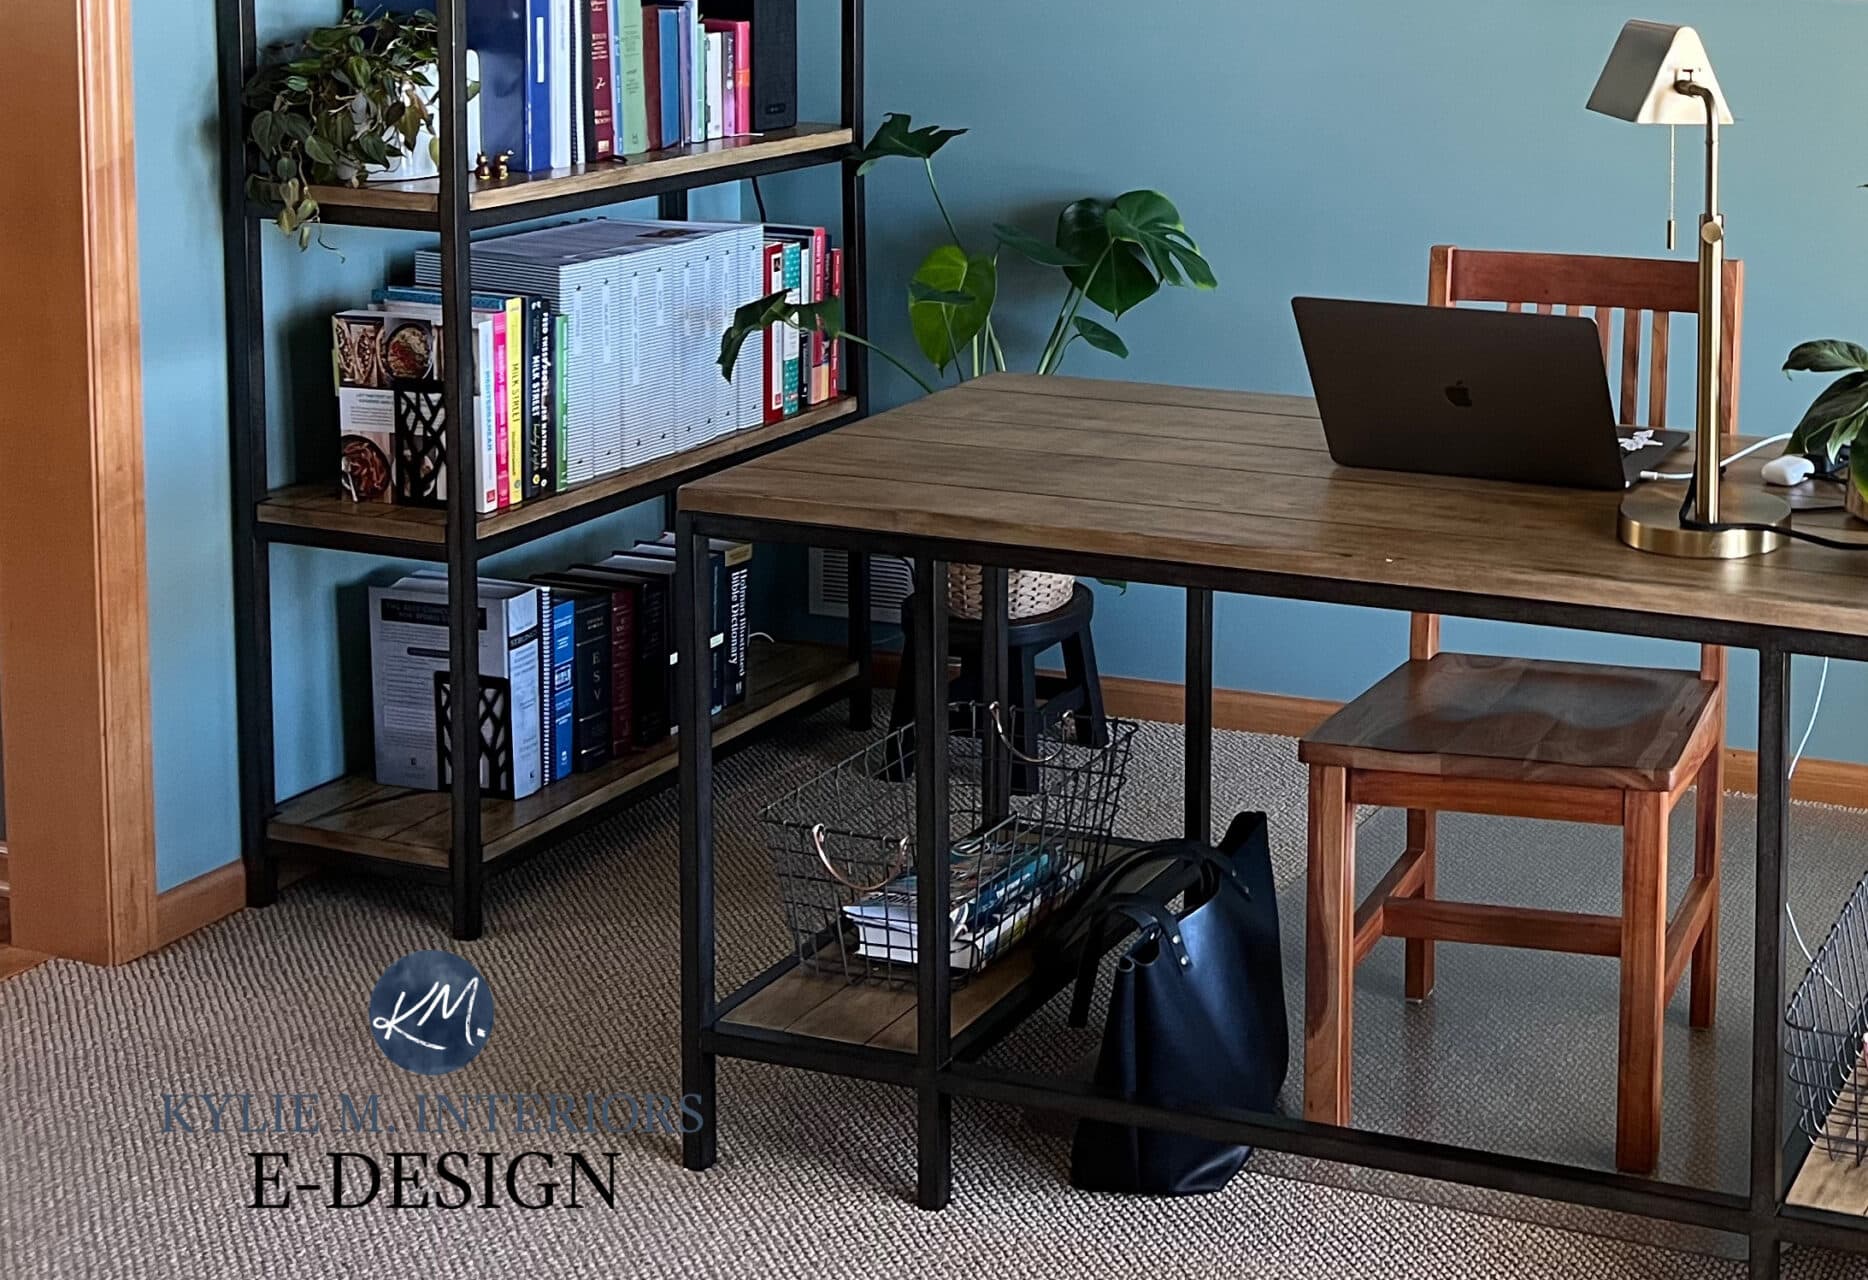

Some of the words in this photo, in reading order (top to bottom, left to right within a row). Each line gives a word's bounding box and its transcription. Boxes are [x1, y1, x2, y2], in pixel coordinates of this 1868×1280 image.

[532, 355, 541, 380] MILK
[485, 370, 493, 452] MEDITERRANEAN
[532, 381, 541, 417] STREET
[731, 571, 740, 602] Bible
[739, 568, 748, 616] Holman
[728, 604, 740, 665] Dictionary
[739, 617, 747, 677] Illustrated
